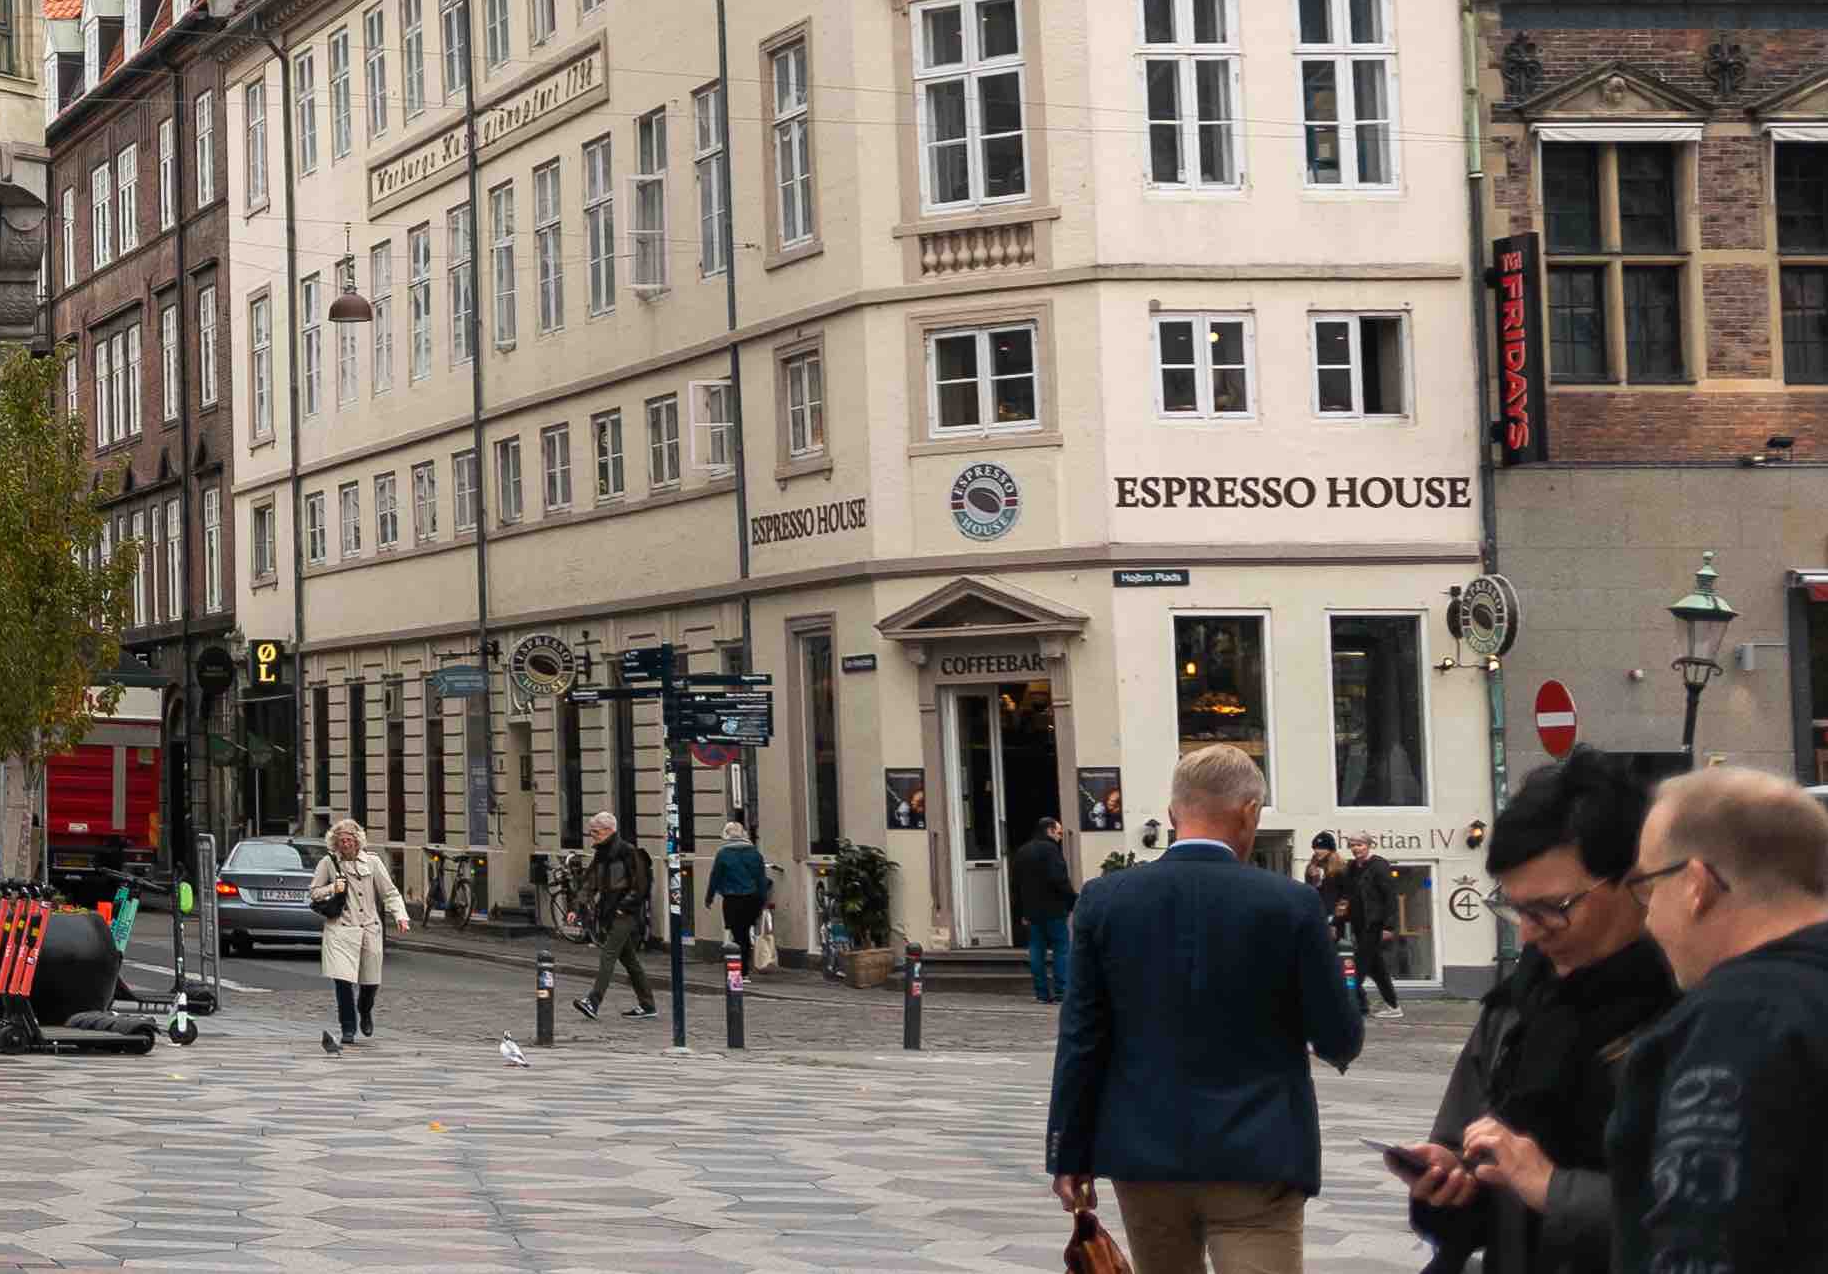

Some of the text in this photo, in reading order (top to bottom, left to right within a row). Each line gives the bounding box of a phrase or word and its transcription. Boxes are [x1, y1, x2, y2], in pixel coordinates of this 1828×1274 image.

[1499, 273, 1529, 450] FRIDAYS
[1114, 476, 1472, 509] ESPRESSO HOUSE
[751, 498, 867, 546] ESPRESSO HOUSE
[257, 643, 278, 683] ØL
[942, 653, 1046, 676] COFFEEBAR
[1430, 829, 1455, 849] IV
